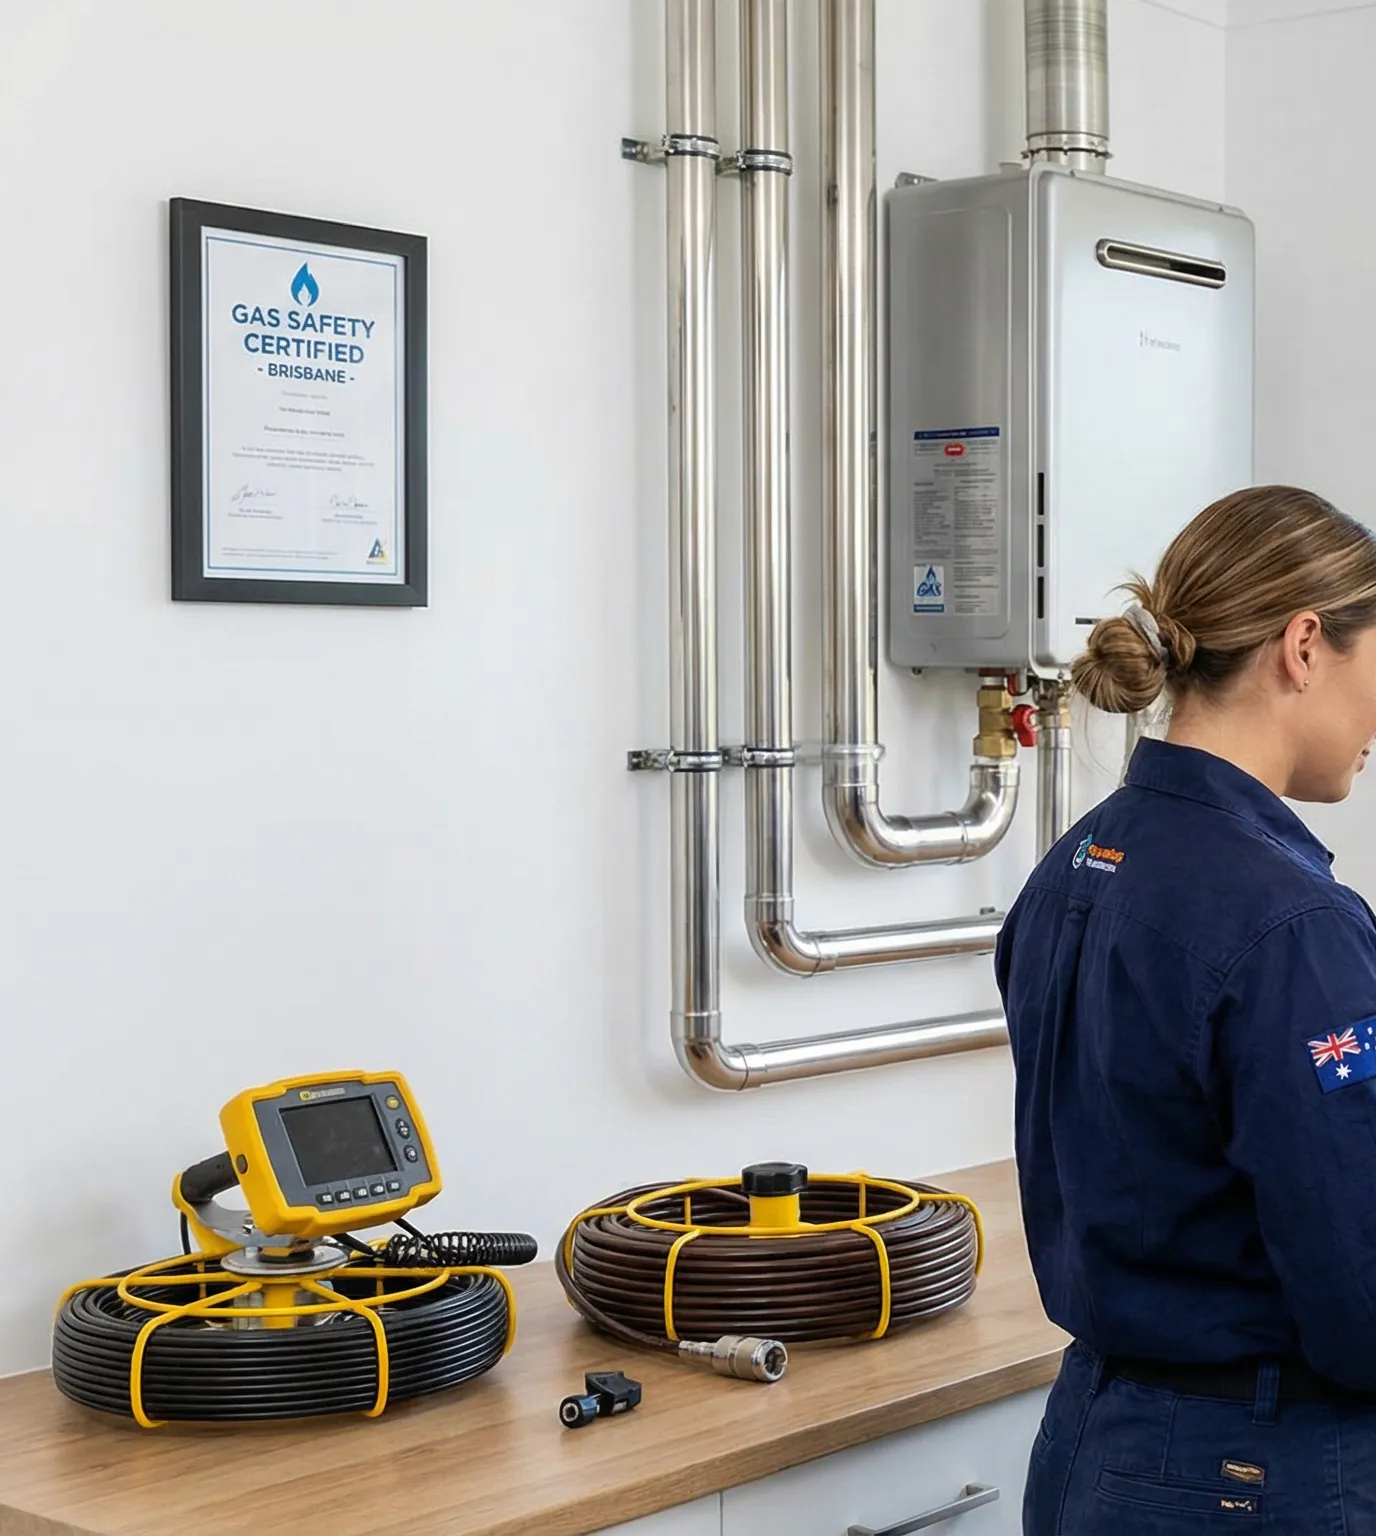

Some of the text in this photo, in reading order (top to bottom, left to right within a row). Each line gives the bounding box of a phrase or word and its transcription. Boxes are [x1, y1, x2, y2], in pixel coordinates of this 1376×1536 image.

[231, 303, 375, 339] GAS SAFETY
[243, 332, 365, 364] CERTIFIED
[267, 362, 346, 384] BRISBANE
